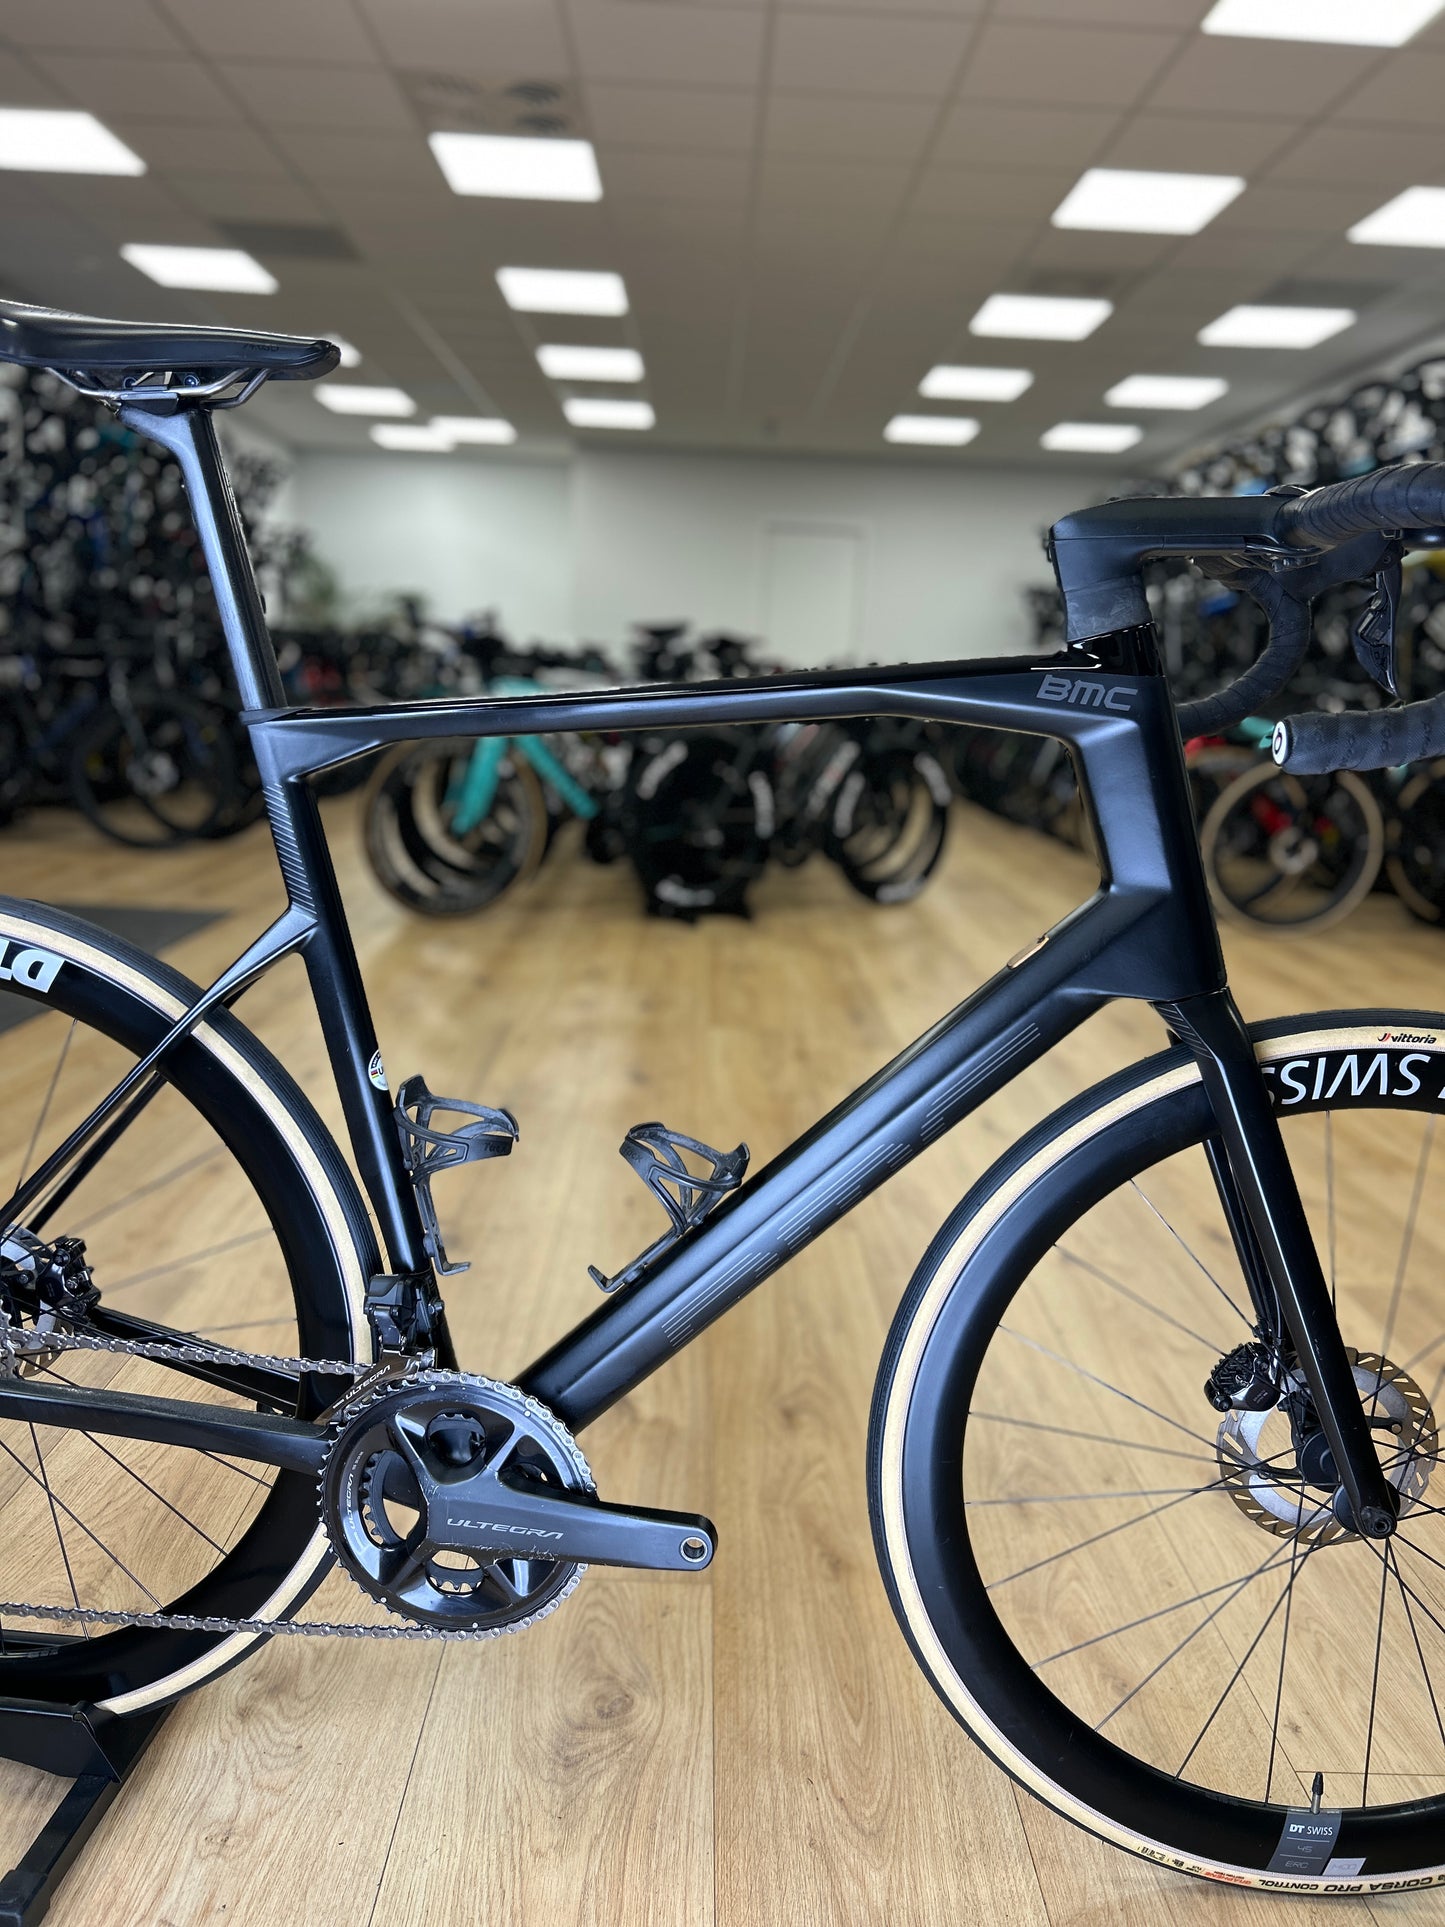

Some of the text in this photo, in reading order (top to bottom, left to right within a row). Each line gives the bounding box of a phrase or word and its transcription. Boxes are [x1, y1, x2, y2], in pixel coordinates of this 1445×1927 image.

[1036, 674, 1138, 711] BMC
[1391, 1033, 1437, 1044] vittoria
[345, 1365, 391, 1400] ULTEGRA
[346, 1473, 355, 1529] ULTEGRA
[447, 1518, 564, 1540] ULTEGRA
[1289, 1824, 1333, 1836] DT SWISS
[1285, 1860, 1309, 1869] ERC
[1259, 1879, 1320, 1890] CONTROL
[1324, 1884, 1364, 1892] PRO
[1370, 1876, 1433, 1892] CORSA
